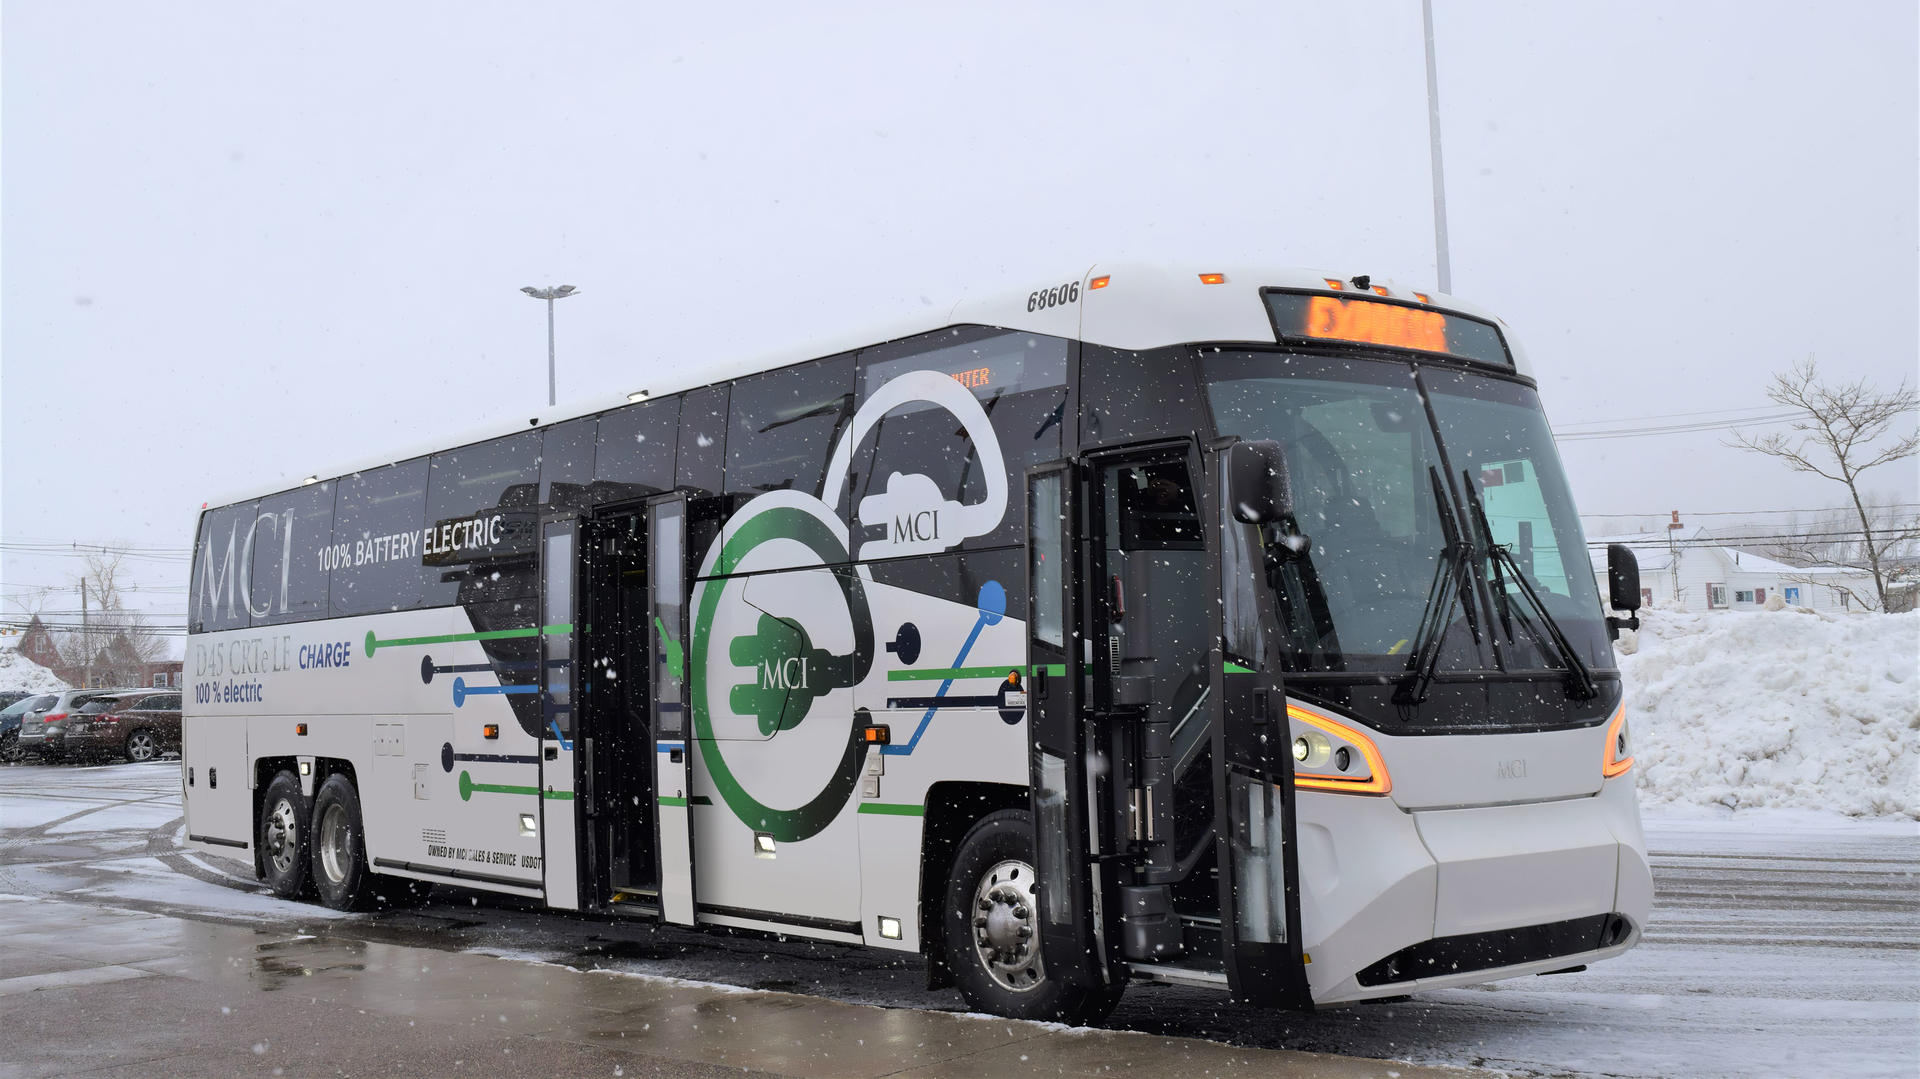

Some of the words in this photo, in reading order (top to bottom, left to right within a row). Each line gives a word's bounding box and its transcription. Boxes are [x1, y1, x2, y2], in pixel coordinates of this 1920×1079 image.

[1027, 281, 1080, 313] 68606
[318, 542, 352, 572] 100%
[355, 530, 420, 567] BATTERY
[423, 515, 501, 556] ELECTRIC
[893, 510, 941, 544] MCI
[198, 508, 295, 622] MCI
[196, 642, 224, 677] D45
[229, 638, 269, 676] CRTe
[272, 635, 291, 673] LE
[299, 641, 351, 670] CHARGE
[762, 657, 809, 690] MCI
[195, 682, 210, 704] 100
[212, 681, 222, 703] %
[223, 678, 263, 703] electric
[1497, 758, 1528, 779] MCI
[427, 844, 448, 859] OWNED
[448, 847, 456, 859] BY
[492, 852, 517, 867] SERVICE
[521, 855, 542, 870] USDOT
